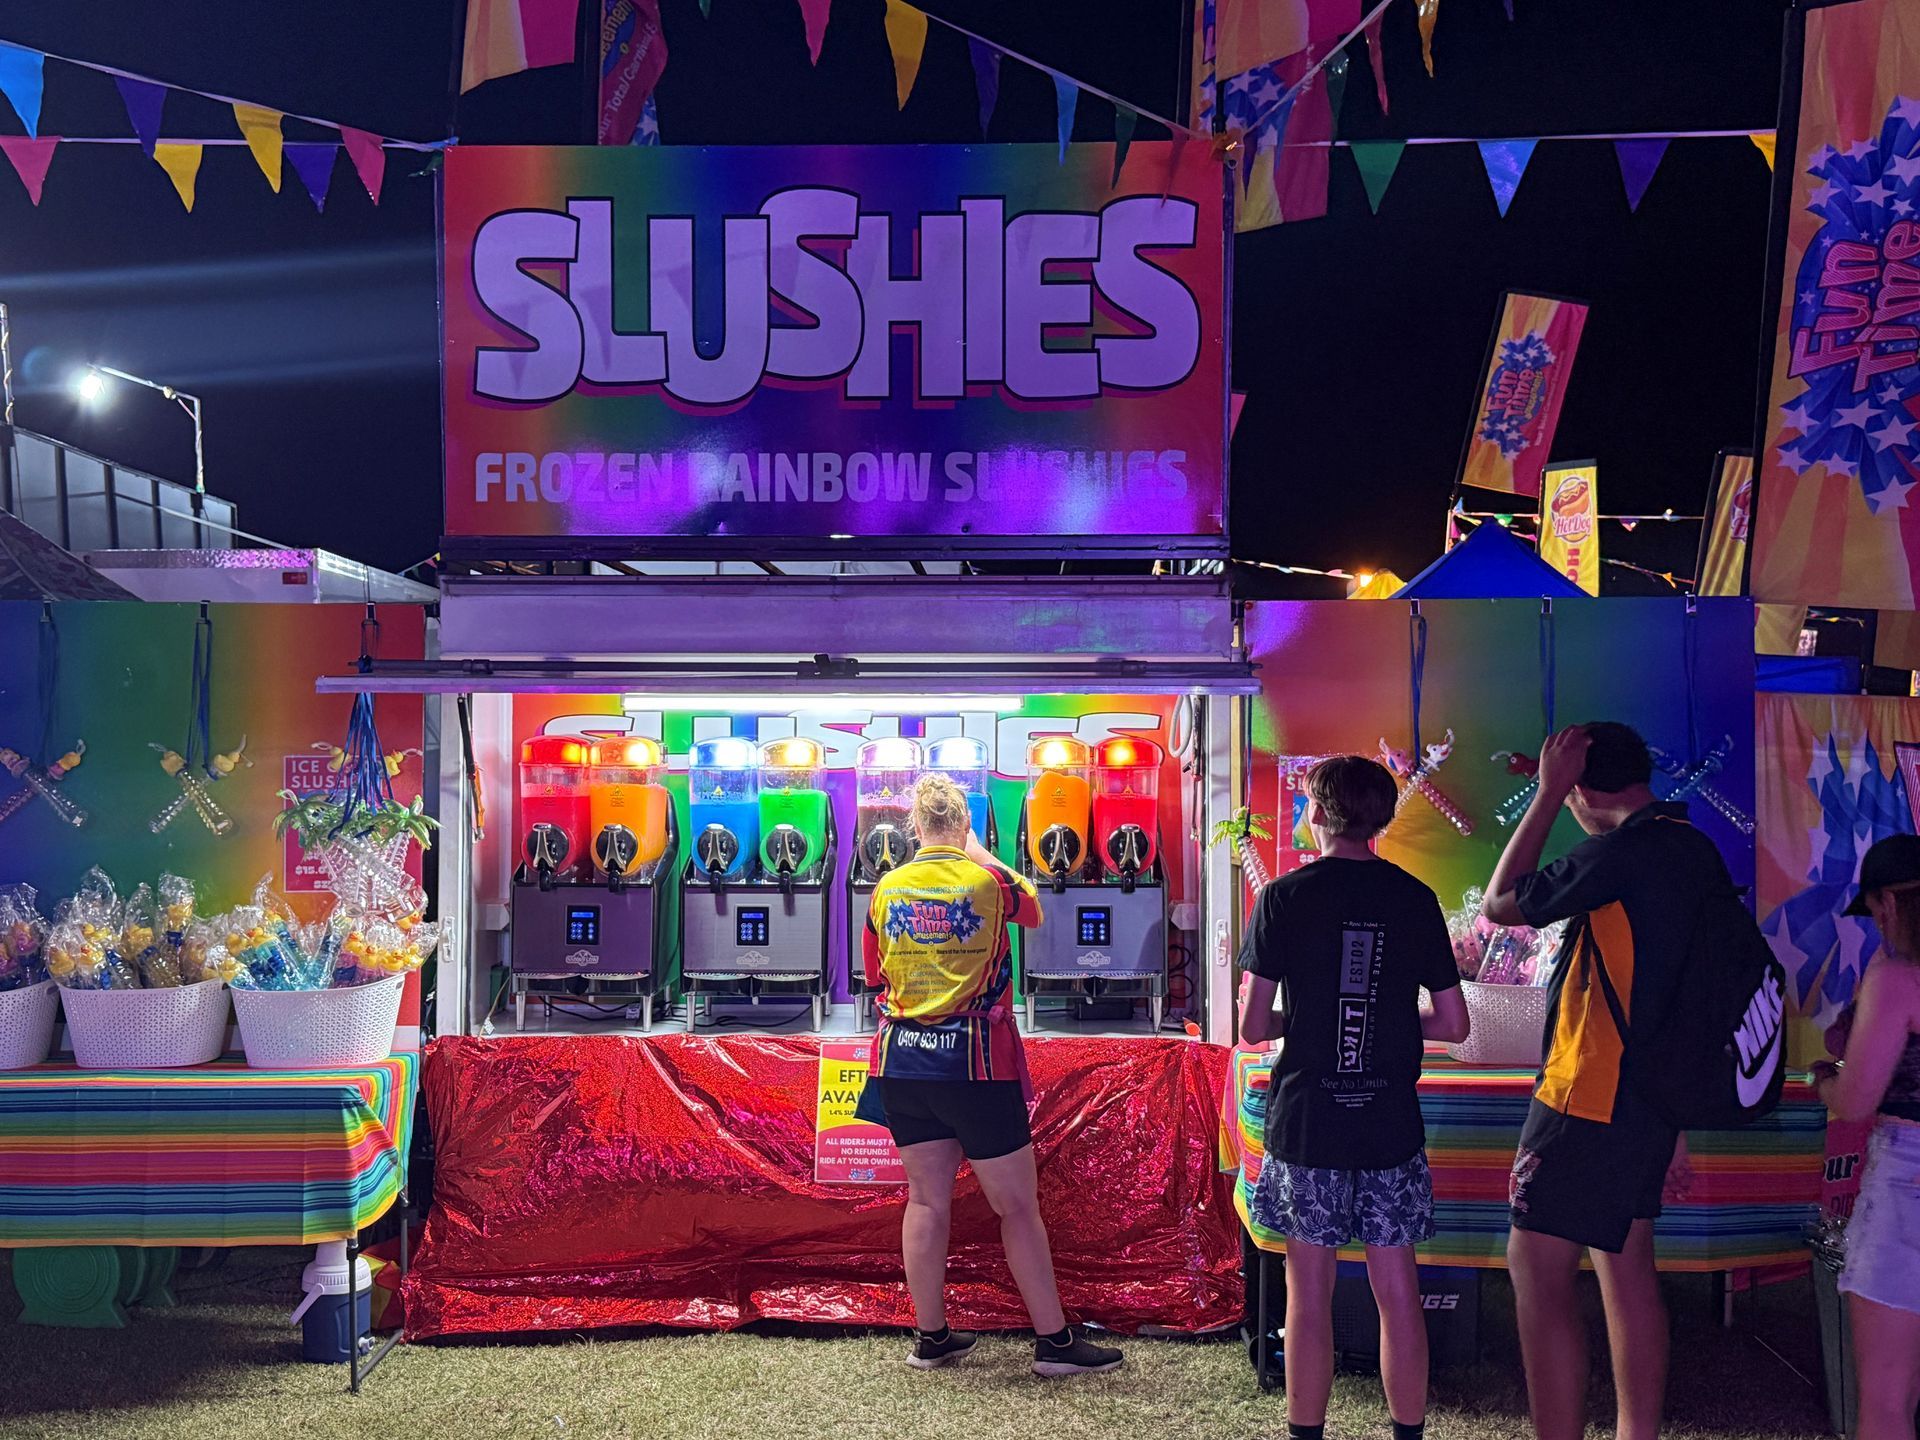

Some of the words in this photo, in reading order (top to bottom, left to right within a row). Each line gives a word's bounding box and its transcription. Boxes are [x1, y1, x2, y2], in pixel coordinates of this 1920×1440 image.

[606, 76, 630, 112] Total
[472, 185, 1201, 403] SLUSHIES
[1788, 240, 1880, 379] Fun
[1852, 220, 1920, 394] Time
[1486, 370, 1518, 412] Fun
[1503, 368, 1536, 420] Time
[475, 452, 673, 502] FROZEN
[690, 452, 930, 502] RAINBOW
[943, 450, 1188, 502] SLUSHIES
[291, 760, 320, 773] ICE
[907, 915, 952, 933] Time
[910, 900, 947, 919] Fun
[1372, 931, 1385, 976] CREATE
[1369, 982, 1379, 1004] THE
[1734, 964, 1783, 1073] NIKE
[898, 1031, 919, 1047] 0407
[920, 1033, 938, 1050] 933
[940, 1033, 957, 1049] 117
[840, 1138, 866, 1146] RIDERS
[867, 1138, 887, 1146] MUST
[841, 1148, 853, 1156] NO
[855, 1148, 890, 1156] REFUNDS!
[819, 1157, 836, 1165] RIDE
[837, 1157, 847, 1165] AT
[849, 1157, 869, 1165] YOUR
[870, 1158, 890, 1166] OWN
[891, 1158, 904, 1166] RIS
